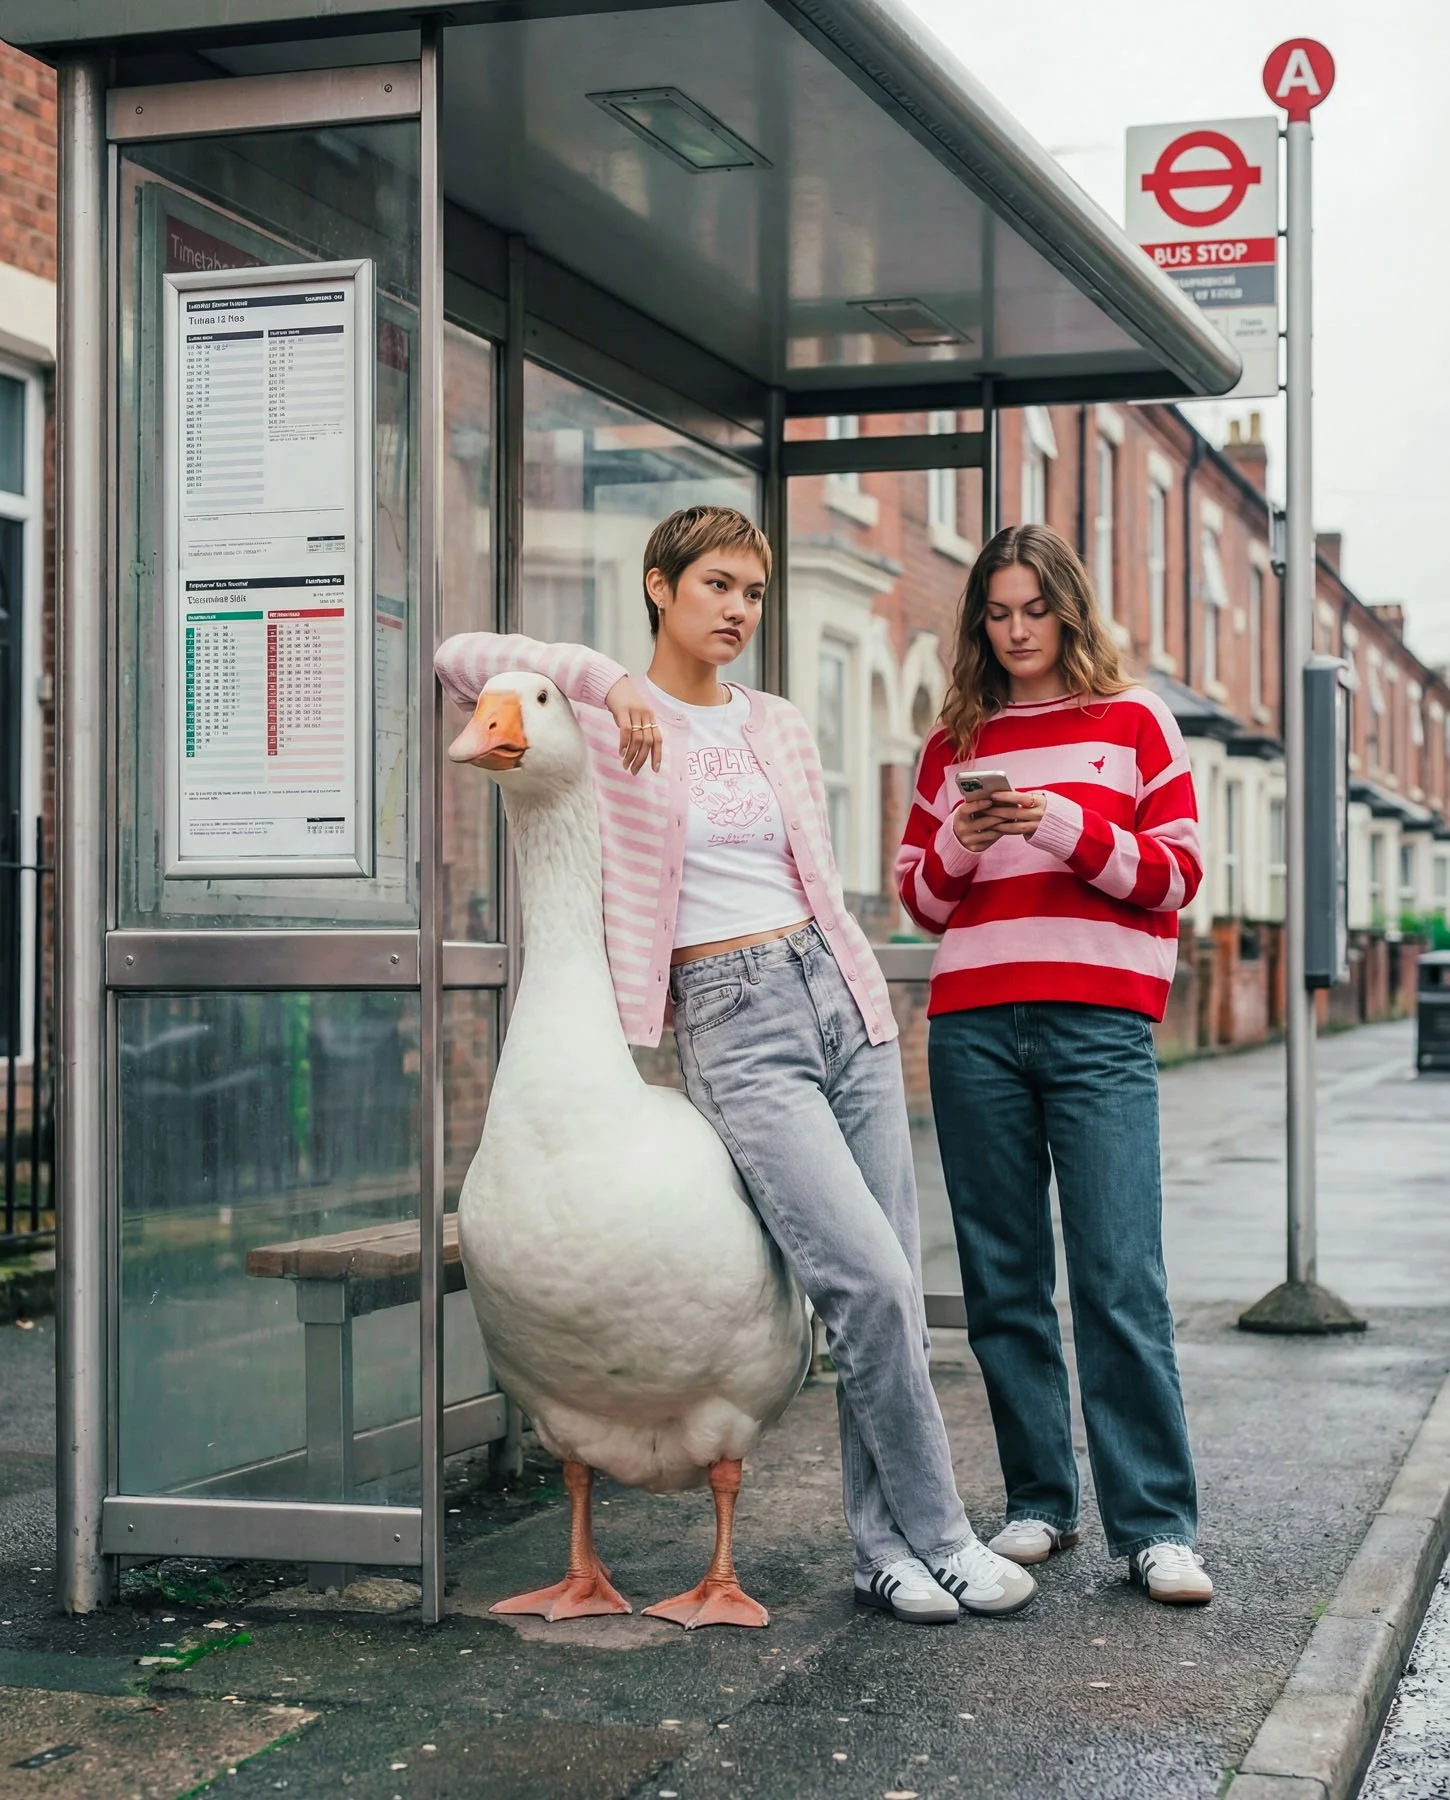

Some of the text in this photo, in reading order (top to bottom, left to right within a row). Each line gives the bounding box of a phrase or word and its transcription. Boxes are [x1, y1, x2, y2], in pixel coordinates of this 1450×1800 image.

[1276, 48, 1322, 98] A
[1154, 242, 1248, 265] BUS STOP
